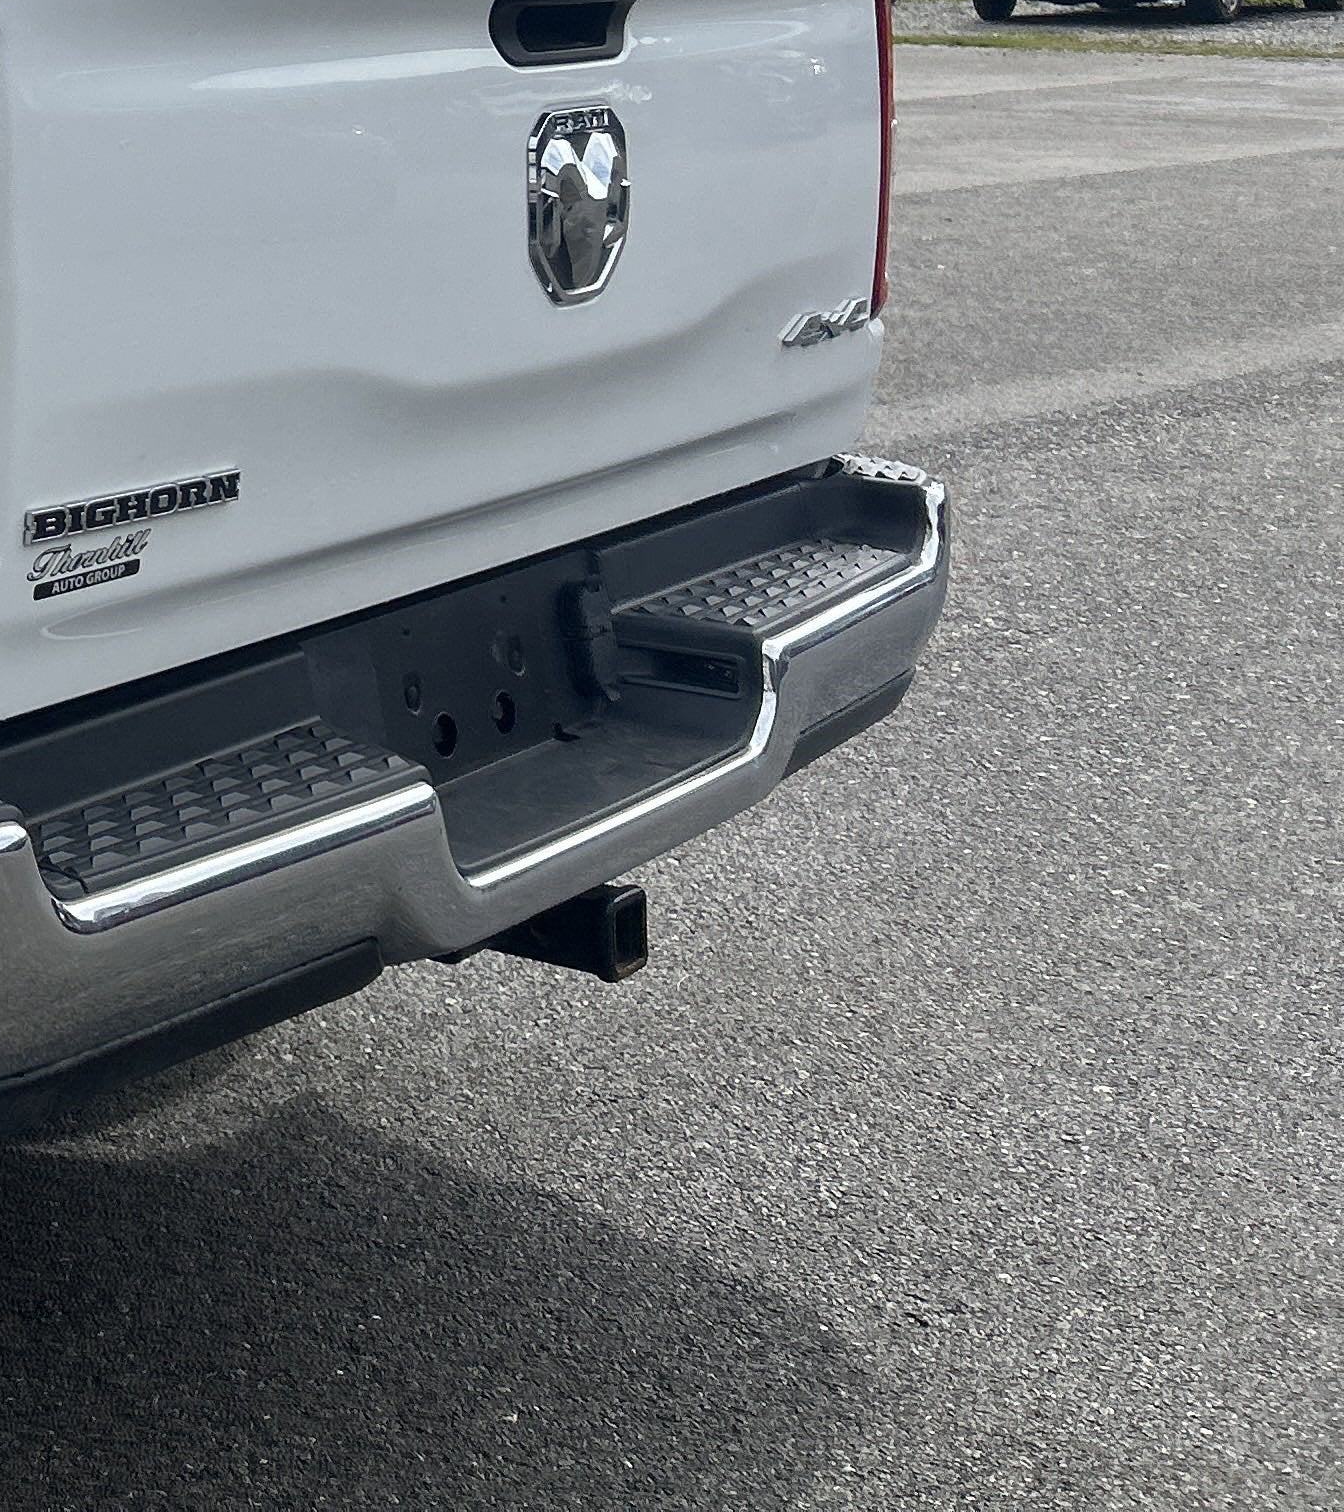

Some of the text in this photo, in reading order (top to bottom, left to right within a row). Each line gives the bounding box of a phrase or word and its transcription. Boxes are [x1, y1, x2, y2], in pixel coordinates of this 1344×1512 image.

[553, 109, 610, 134] RAM
[24, 468, 241, 545] BIGHORN
[27, 528, 151, 582] Thornhill
[52, 564, 126, 595] AUTO GROUP
